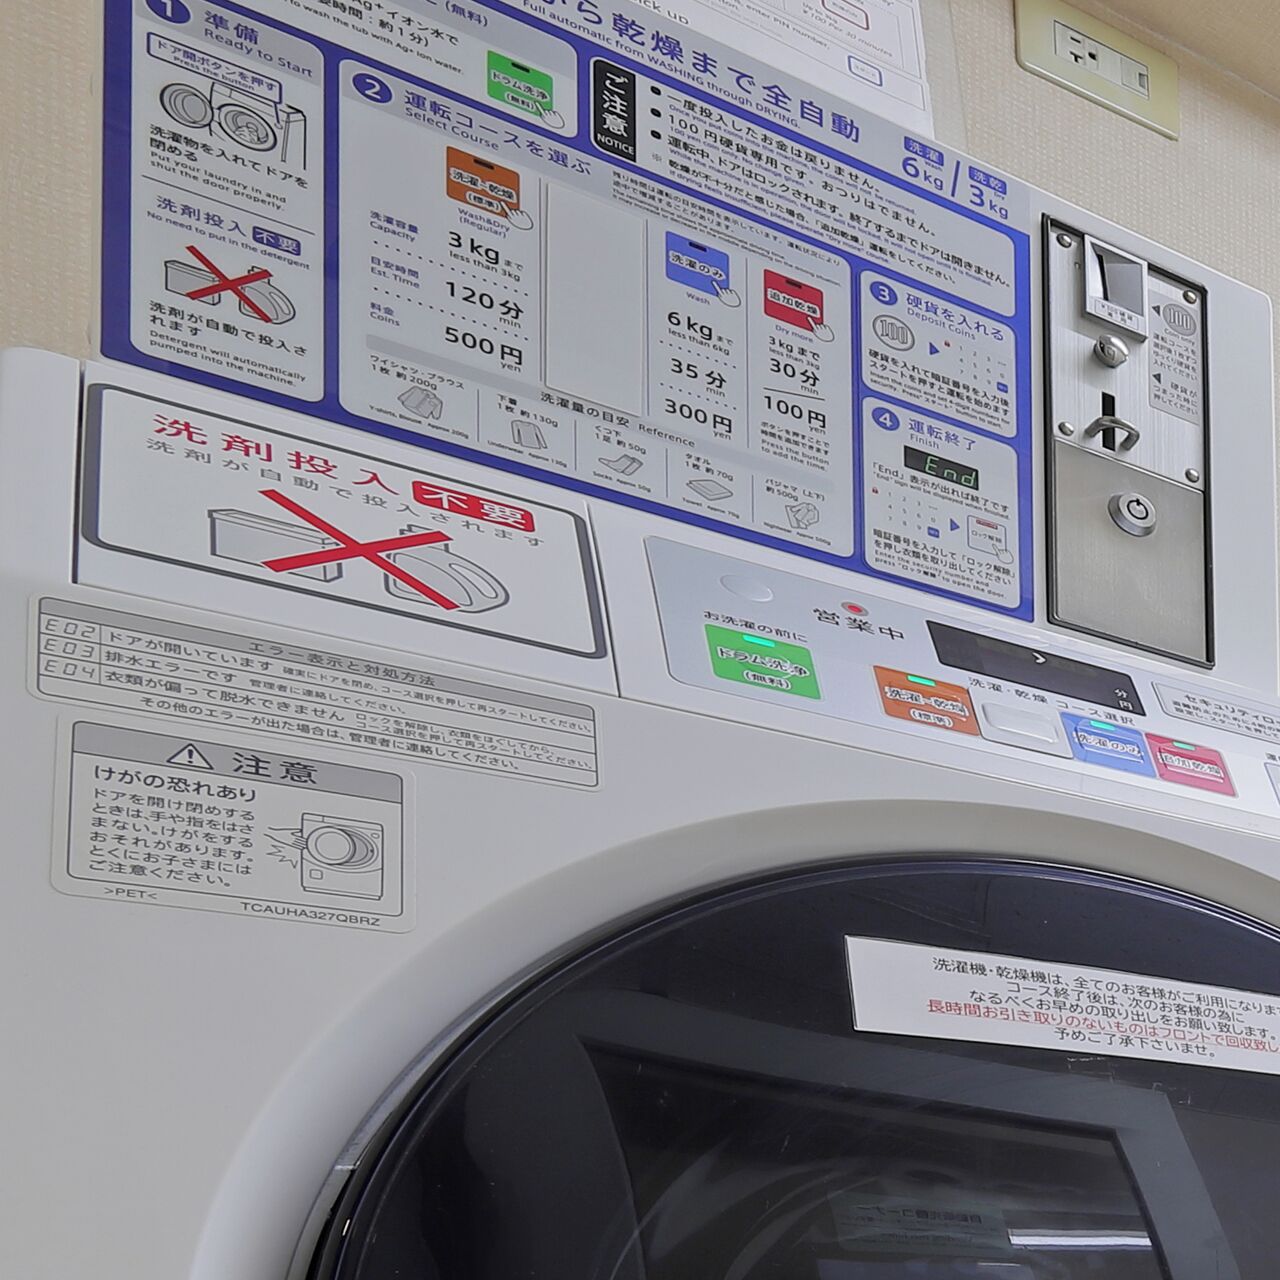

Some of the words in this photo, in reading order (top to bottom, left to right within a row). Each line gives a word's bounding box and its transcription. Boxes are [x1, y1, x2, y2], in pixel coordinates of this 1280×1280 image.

[204, 10, 260, 45] 準備
[204, 28, 253, 56] Ready
[257, 50, 273, 62] to
[278, 57, 313, 78] Start
[549, 10, 612, 45] automatic
[615, 38, 645, 59] from
[647, 52, 704, 85] WASHING
[707, 81, 752, 107] through
[602, 72, 629, 137] ご注意
[404, 89, 592, 176] 運転コースを選ぶ
[405, 107, 448, 132] Select
[451, 125, 500, 150] Course
[597, 133, 635, 155] NOTICE
[150, 138, 198, 162] 閉める
[151, 151, 170, 164] Put
[174, 158, 199, 173] your
[204, 168, 248, 191] laundry
[266, 189, 287, 203] and
[151, 160, 177, 175] shut
[180, 169, 199, 182] the
[203, 178, 230, 192] door
[233, 189, 284, 211] properly.
[902, 155, 921, 178] 6
[923, 167, 945, 192] kg
[156, 195, 247, 238] 洗剤投入
[969, 183, 986, 208] 3
[989, 196, 1008, 221] kg
[165, 217, 192, 231] need
[208, 231, 227, 244] put
[260, 246, 310, 270] detergent
[370, 220, 416, 243] Capacity
[459, 217, 508, 239] (Regular)
[448, 231, 463, 249] 3
[470, 238, 500, 266] kg
[449, 250, 470, 264] less
[473, 259, 498, 274] than
[391, 273, 421, 289] Time
[686, 291, 711, 306] Wash
[150, 314, 202, 337] れます
[370, 311, 401, 327] Coins
[667, 311, 681, 327] 6
[687, 316, 713, 342] kg
[775, 323, 790, 338] Dry
[906, 293, 1004, 342] 硬貨を入れる
[907, 306, 947, 329] Deposit
[948, 323, 976, 340] Coins
[150, 329, 207, 354] Detergent
[210, 346, 230, 359] will
[233, 354, 307, 382] automatically
[689, 335, 711, 349] than
[779, 338, 794, 354] kg
[150, 338, 197, 360] pumped
[201, 352, 222, 366] into
[225, 360, 244, 373] the
[246, 366, 297, 388] machine.
[638, 423, 696, 448] Reference
[908, 416, 977, 451] 運転終了
[910, 433, 940, 449] Finish
[154, 413, 399, 497] 洗剤投入
[147, 438, 545, 549] 洗剤が自動で投入されます
[702, 608, 809, 643] お洗濯の前に
[812, 606, 906, 641] 営業中
[43, 637, 95, 658] E03
[105, 650, 237, 684] 排水エラーです
[44, 617, 96, 639] E02
[109, 631, 274, 671] ドアが開いています
[43, 659, 95, 679] E04
[94, 764, 257, 803] けがの恐れあり
[232, 750, 318, 785] 注意
[94, 787, 256, 822] ドアを開け閉めする
[89, 830, 254, 863] おそれがあります。
[89, 843, 253, 876] とくにお子さまには
[88, 859, 231, 888] ご注意ください。
